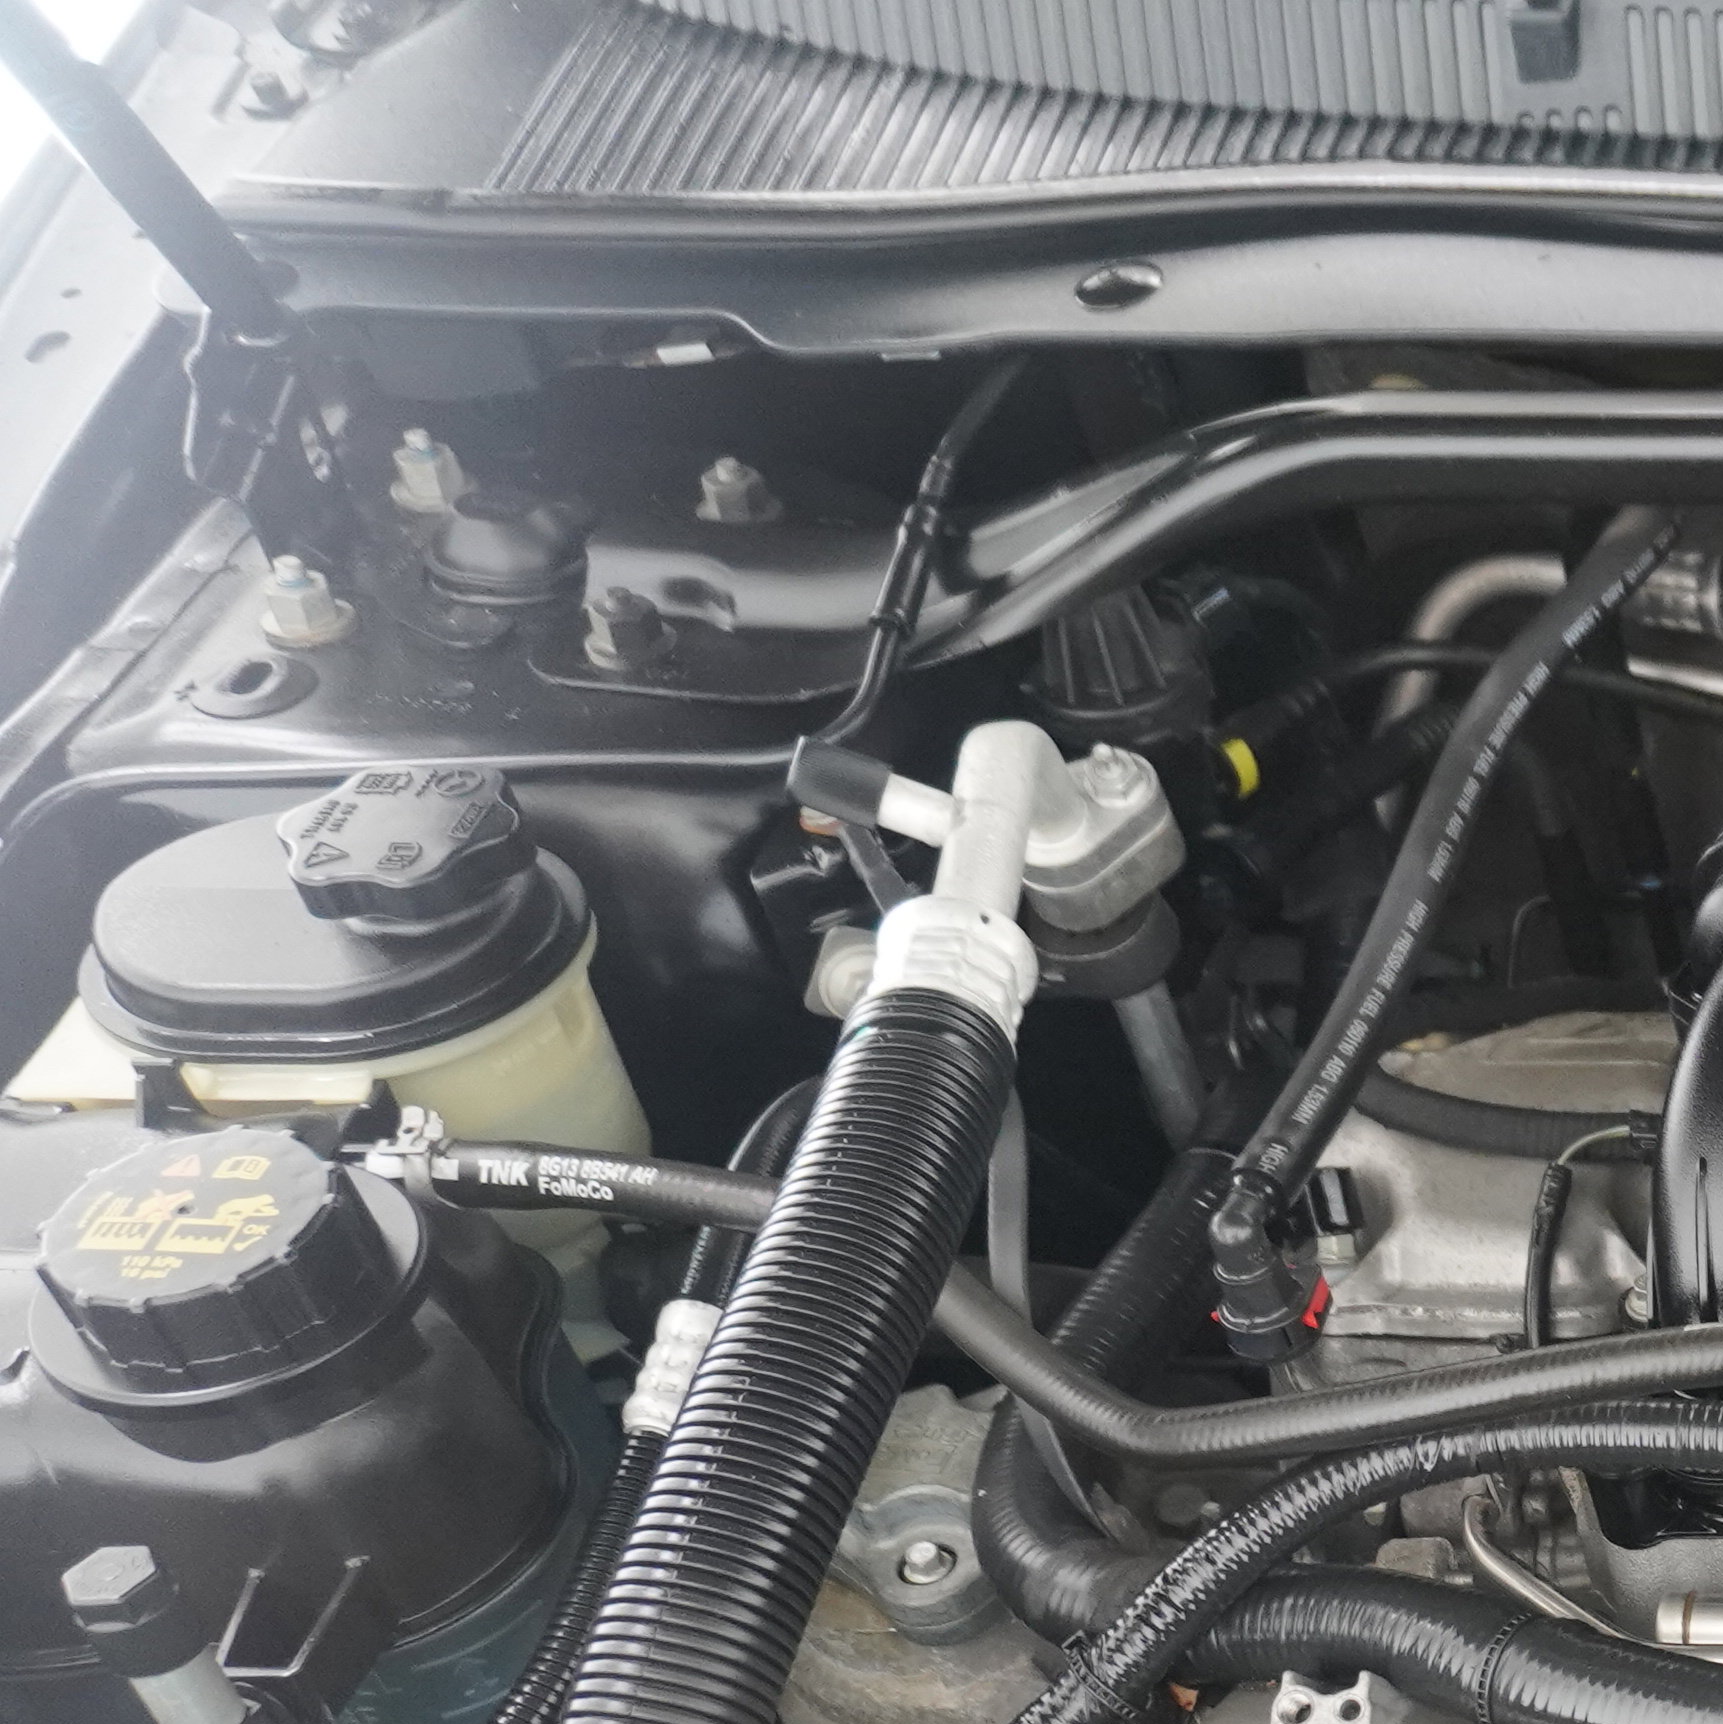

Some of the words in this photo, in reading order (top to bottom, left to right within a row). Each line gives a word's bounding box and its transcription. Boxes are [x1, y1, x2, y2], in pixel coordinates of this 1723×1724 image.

[1377, 929, 1414, 990] PRESSURE
[1359, 987, 1386, 1018] FUEL
[478, 1158, 530, 1187] TNK
[538, 1176, 615, 1201] FoMoCo
[243, 1223, 271, 1236] OK
